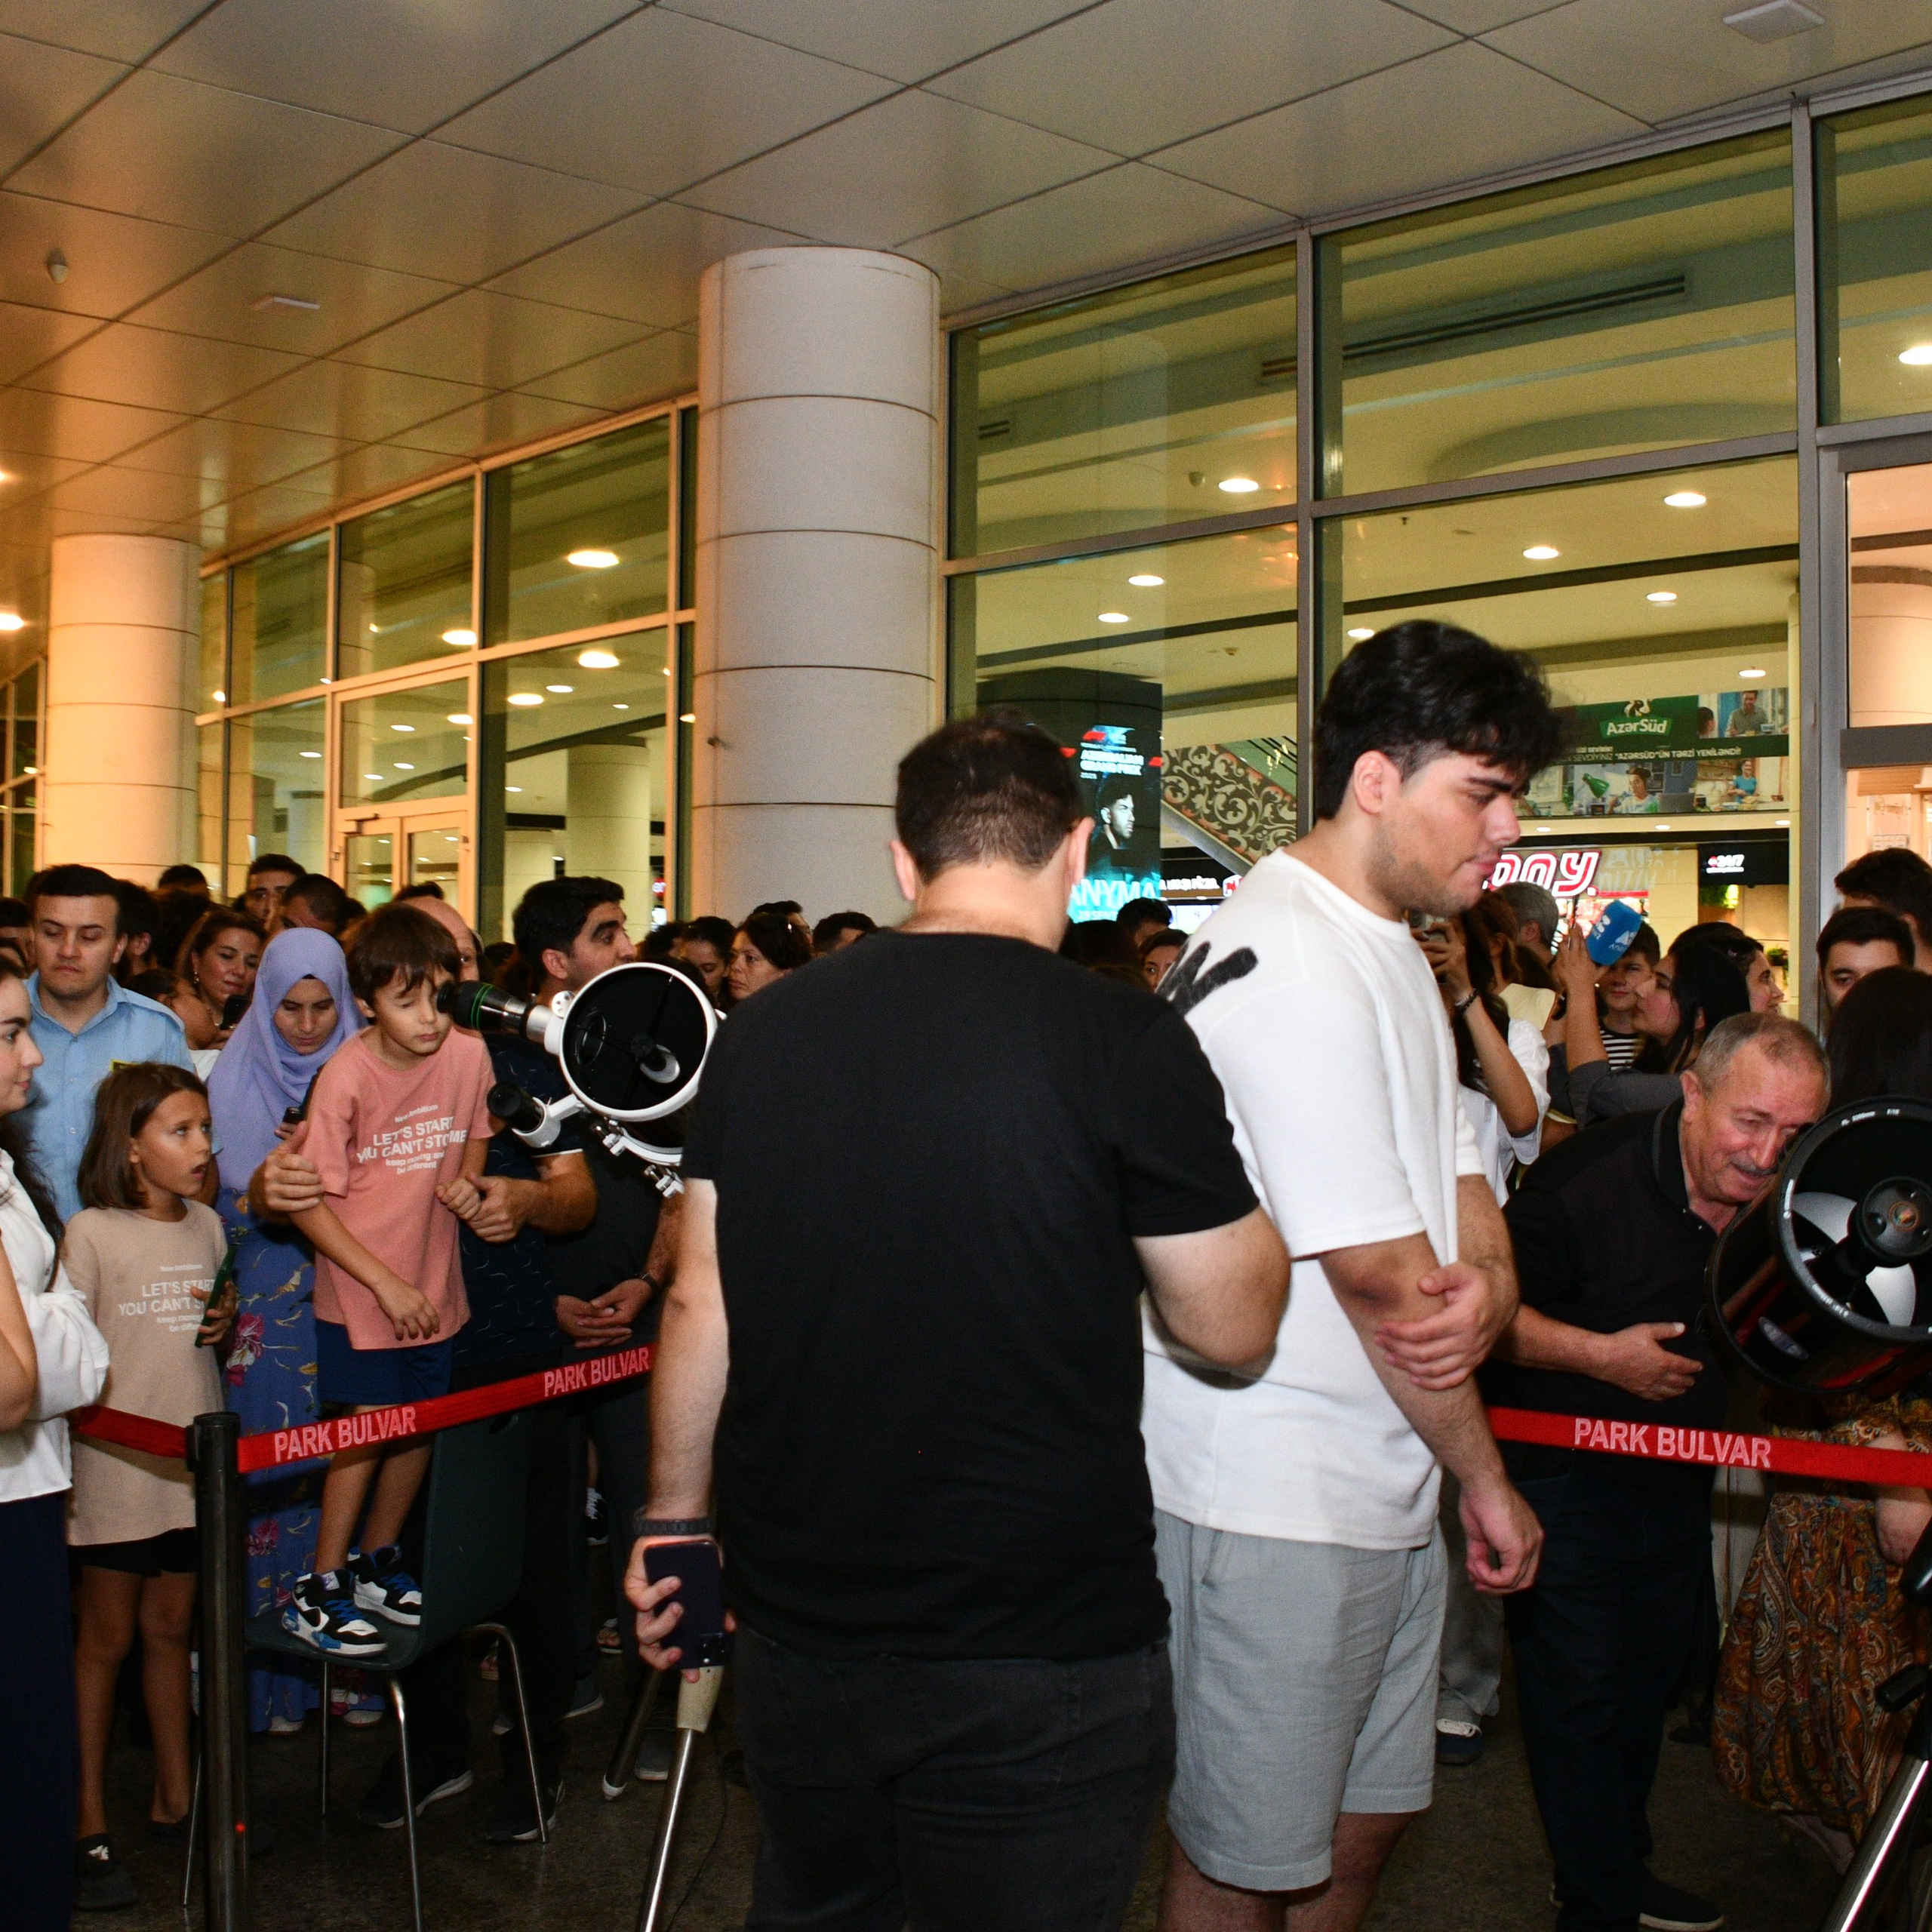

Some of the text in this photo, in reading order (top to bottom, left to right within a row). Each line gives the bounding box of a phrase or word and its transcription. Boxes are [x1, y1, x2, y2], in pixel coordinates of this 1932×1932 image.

[1607, 718, 1667, 735] AzərSüd
[373, 1116, 454, 1146] LET'S START
[382, 1139, 423, 1158] CAN'T
[449, 1130, 467, 1143] ME
[142, 1281, 181, 1297] LET'S
[118, 1301, 147, 1316] YOU
[151, 1297, 191, 1313] CAN'T
[544, 1346, 649, 1397] PARK BULVAR
[275, 1406, 416, 1463] PARK BULVAR
[1574, 1417, 1771, 1469] PARK BULVAR
